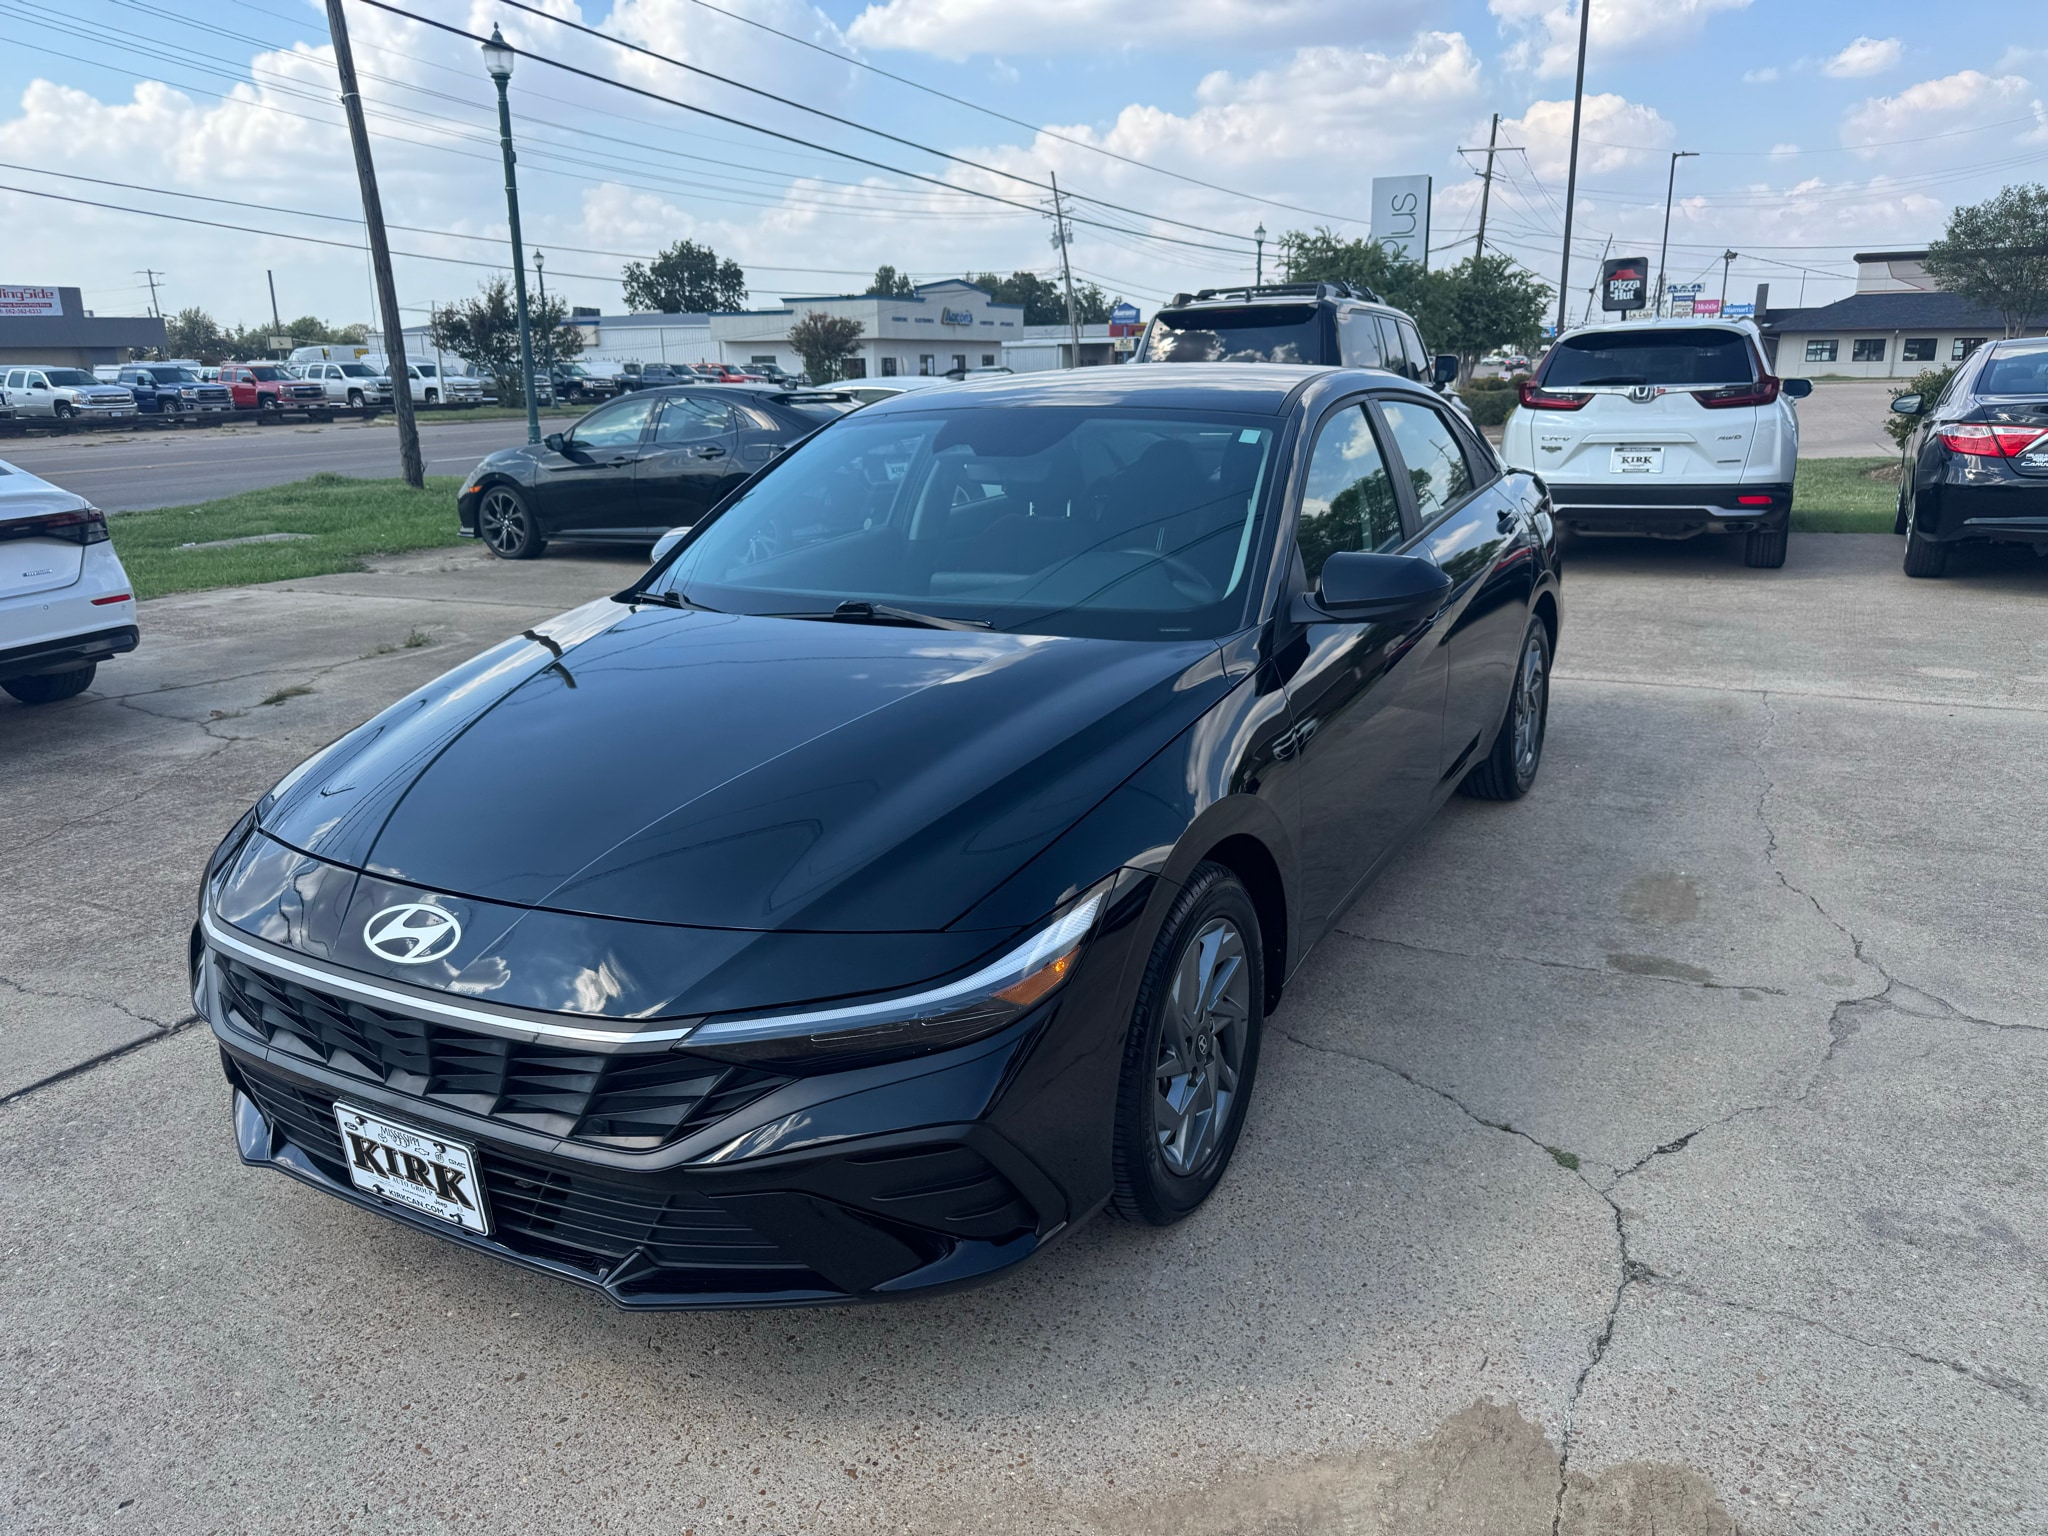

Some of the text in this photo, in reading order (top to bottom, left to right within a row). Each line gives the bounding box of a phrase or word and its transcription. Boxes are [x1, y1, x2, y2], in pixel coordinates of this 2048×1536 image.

[1610, 279, 1640, 292] Pizza
[0, 288, 54, 301] ingSide
[1610, 289, 1635, 300] Hut
[944, 308, 973, 324] Aaron's
[1621, 456, 1652, 464] KIRK
[448, 1158, 466, 1169] GMC
[345, 1130, 475, 1211] KIRK
[410, 1184, 433, 1196] GROUP
